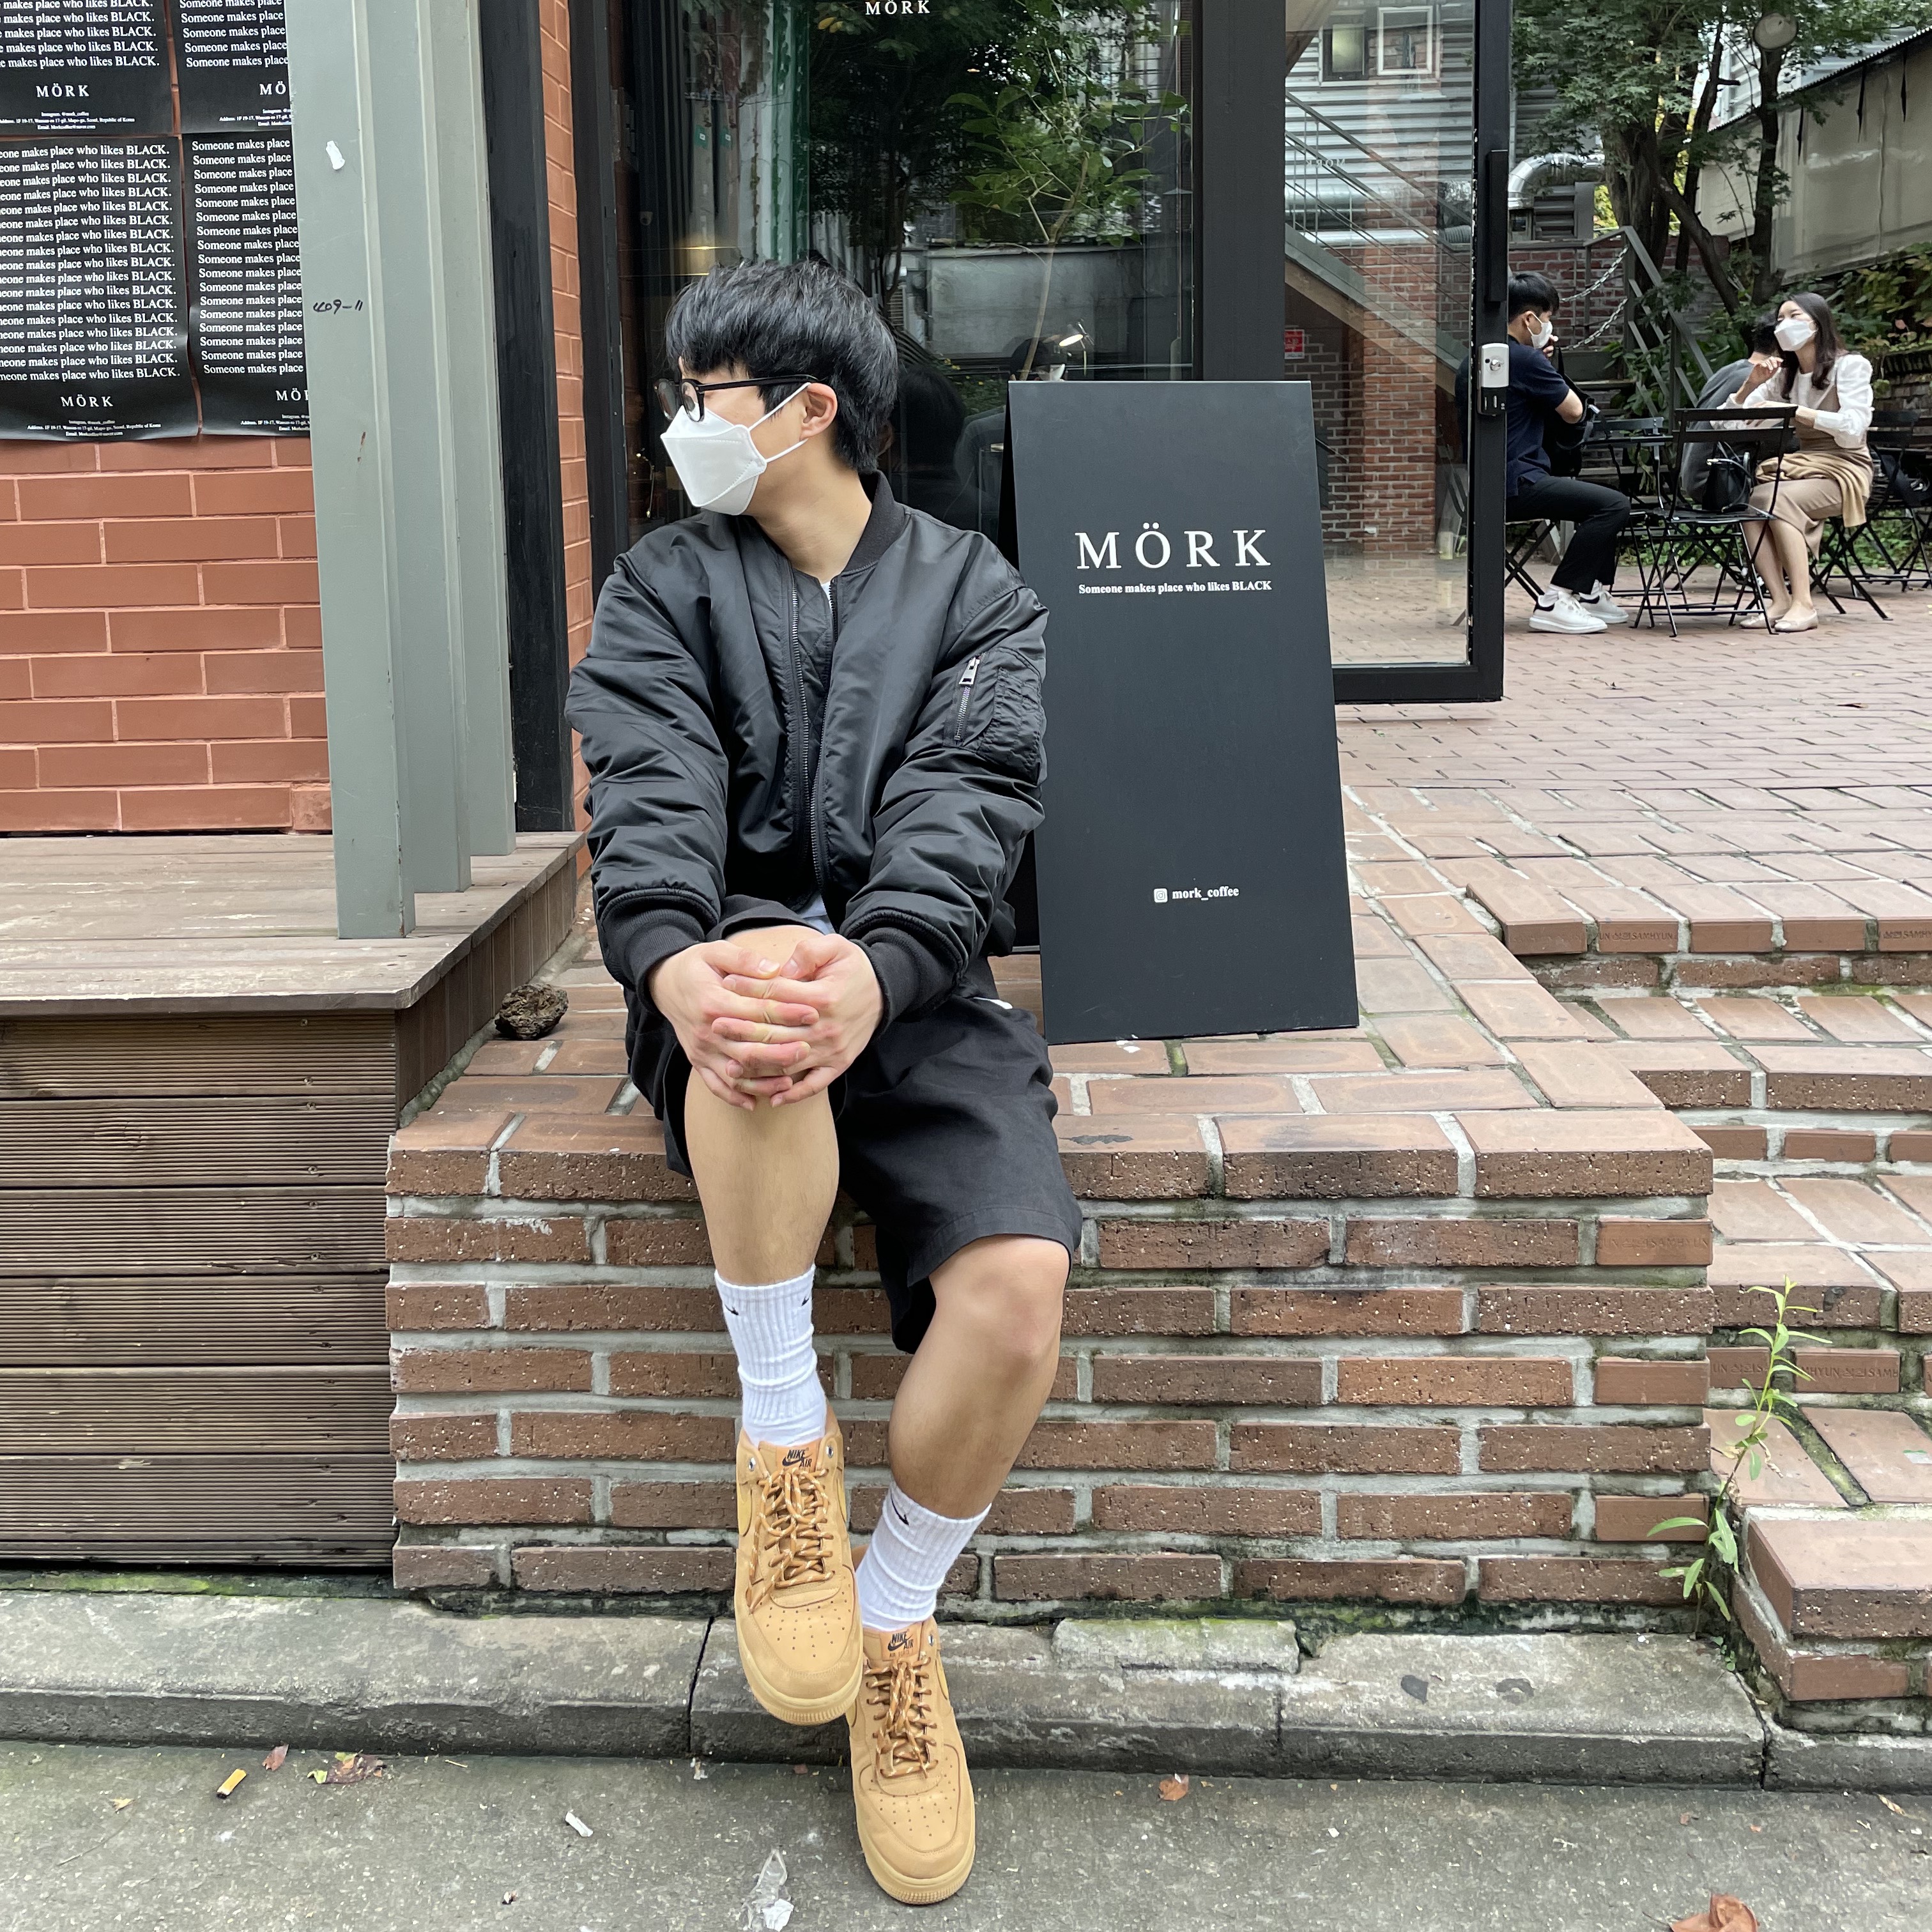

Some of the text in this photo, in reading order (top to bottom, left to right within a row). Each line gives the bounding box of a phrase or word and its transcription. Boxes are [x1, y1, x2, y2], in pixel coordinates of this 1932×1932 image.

[865, 0, 930, 15] MÖRK
[4, 11, 155, 26] makes place who likes BLACK.
[181, 10, 284, 23] Someone makes place
[4, 26, 157, 40] makes place who likes BLACK.
[183, 25, 286, 38] Someone makes place
[6, 41, 158, 55] makes place who likes BLACK.
[185, 40, 287, 53] Someone makes place
[8, 56, 160, 70] makes place who likes BLACK.
[186, 55, 288, 68] Someone makes place
[36, 82, 89, 97] MÖRK
[259, 80, 286, 95] MÖ
[22, 144, 170, 158] makes place who likes BLACK.
[192, 138, 290, 151] Someone makes place
[22, 175, 50, 186] makes
[52, 174, 75, 187] place
[77, 172, 99, 183] who
[101, 172, 125, 183] likes
[127, 172, 171, 183] BLACK.
[194, 167, 293, 180] Someone makes place
[24, 201, 172, 215] makes place who likes BLACK.
[195, 195, 295, 208] Someone makes place
[26, 229, 174, 243] makes place who likes BLACK.
[197, 224, 298, 236] Someone makes place
[26, 257, 175, 272] makes place who likes BLACK.
[198, 253, 300, 264] Someone makes place
[26, 285, 176, 299] makes place who likes BLACK.
[199, 280, 302, 293] Someone makes place
[26, 312, 178, 326] makes place who likes BLACK.
[200, 308, 302, 320] Someone makes place
[27, 340, 176, 355] makes place who likes BLACK.
[200, 335, 303, 348] Someone makes place
[29, 371, 59, 380] makes
[61, 370, 86, 382] place
[89, 369, 109, 379] who
[112, 369, 134, 378] likes
[135, 367, 180, 378] BLACK.
[203, 363, 303, 375] Someone makes place
[60, 394, 113, 407] MÖRK
[276, 388, 308, 401] MÖ
[1075, 522, 1271, 569] MÖRK
[1078, 581, 1272, 594] Someone makes place who likes BLACK
[1172, 886, 1239, 901] mork_coffee
[786, 1449, 806, 1459] NIKE
[799, 1458, 813, 1468] AIR
[891, 1631, 907, 1643] NIKE
[904, 1639, 914, 1650] AIR
